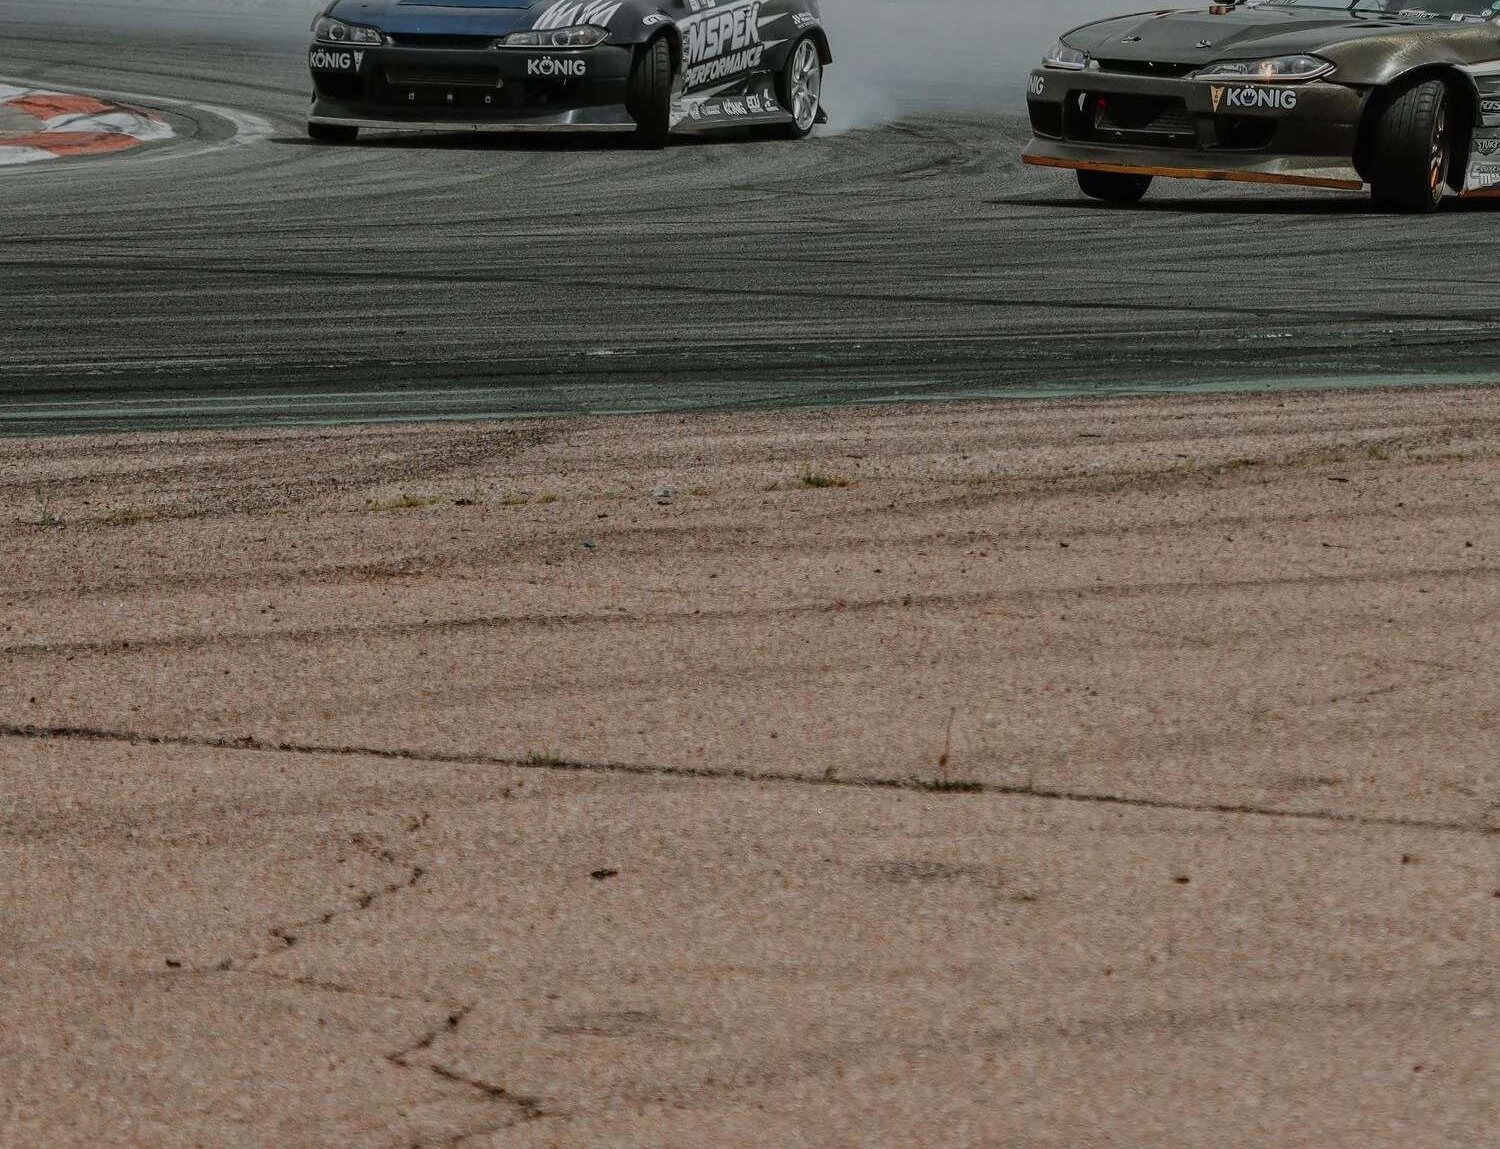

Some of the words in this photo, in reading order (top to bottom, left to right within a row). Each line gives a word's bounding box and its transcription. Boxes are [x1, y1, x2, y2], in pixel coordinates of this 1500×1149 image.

[688, 2, 761, 66] MSPEK
[309, 49, 350, 68] KÖNIG
[527, 56, 586, 76] KÖNIG
[685, 43, 764, 90] PERFORMANCE
[1028, 75, 1044, 95] NIG
[1227, 84, 1297, 110] KÖNIG
